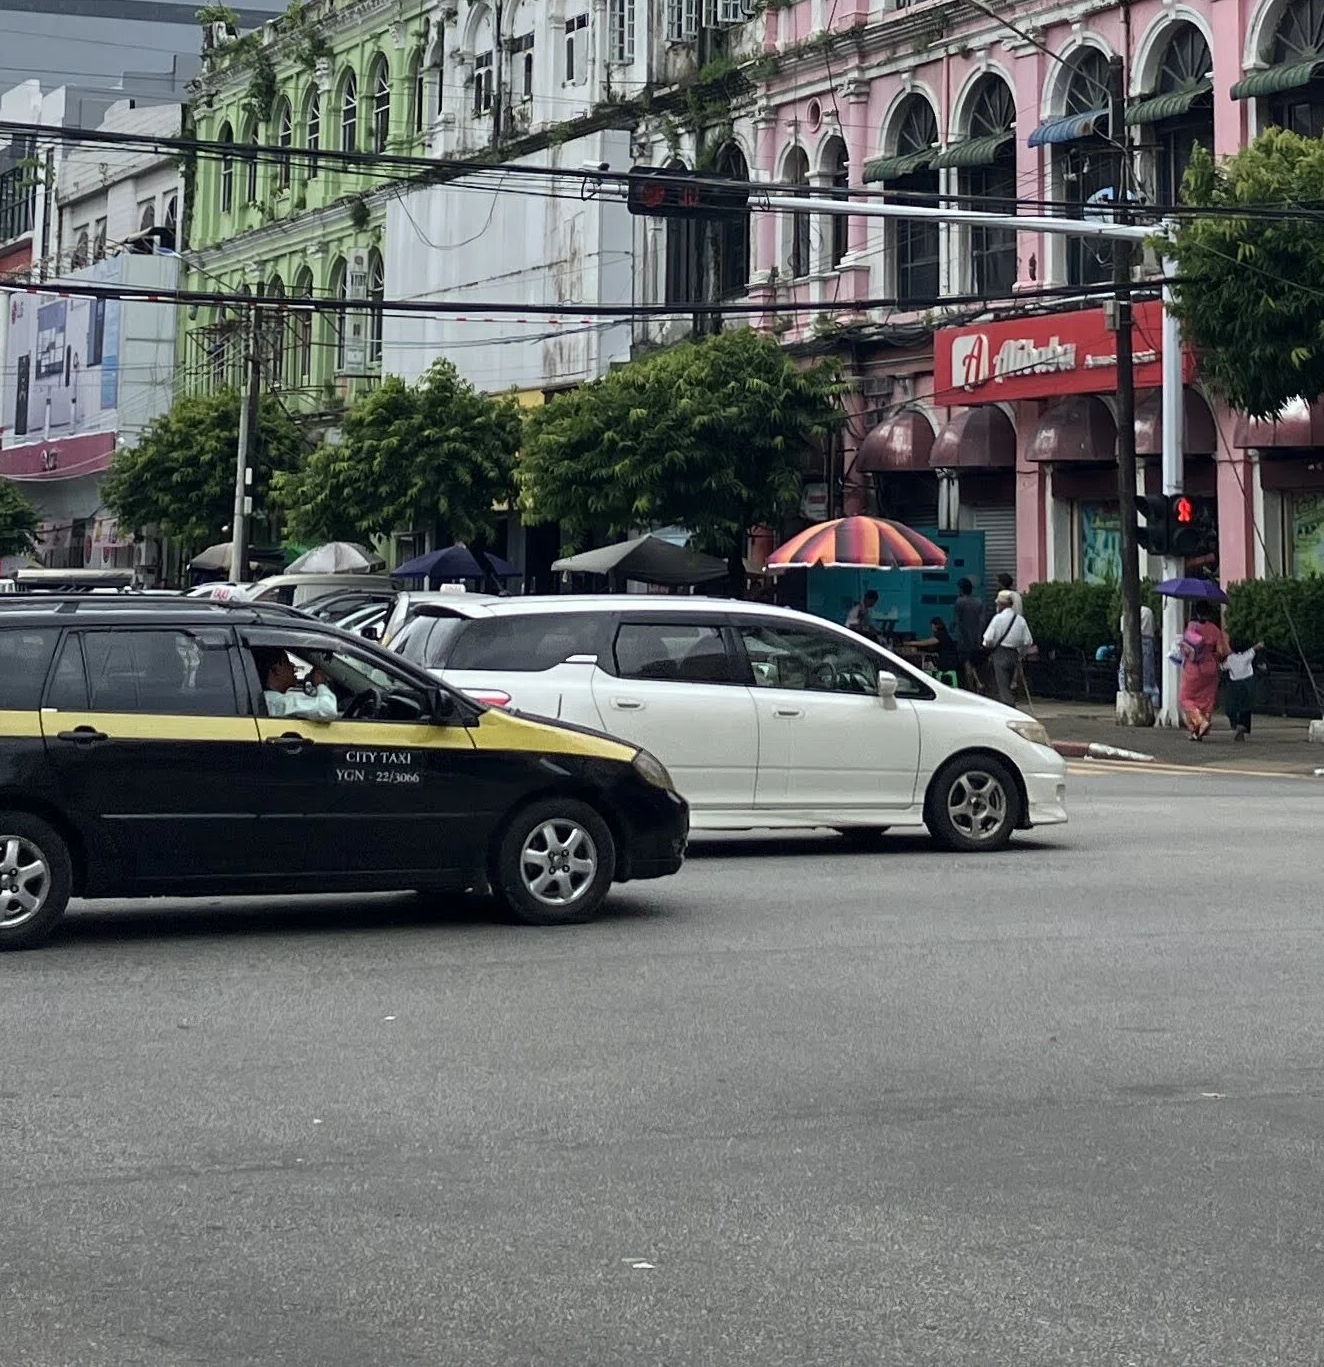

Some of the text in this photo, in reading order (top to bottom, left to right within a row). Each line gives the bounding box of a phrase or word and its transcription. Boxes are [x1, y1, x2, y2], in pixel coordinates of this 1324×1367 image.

[992, 336, 1076, 384] Alibaba
[345, 750, 411, 764] CITY TAXI
[336, 769, 365, 782] YGN
[376, 770, 420, 784] 22/3066
